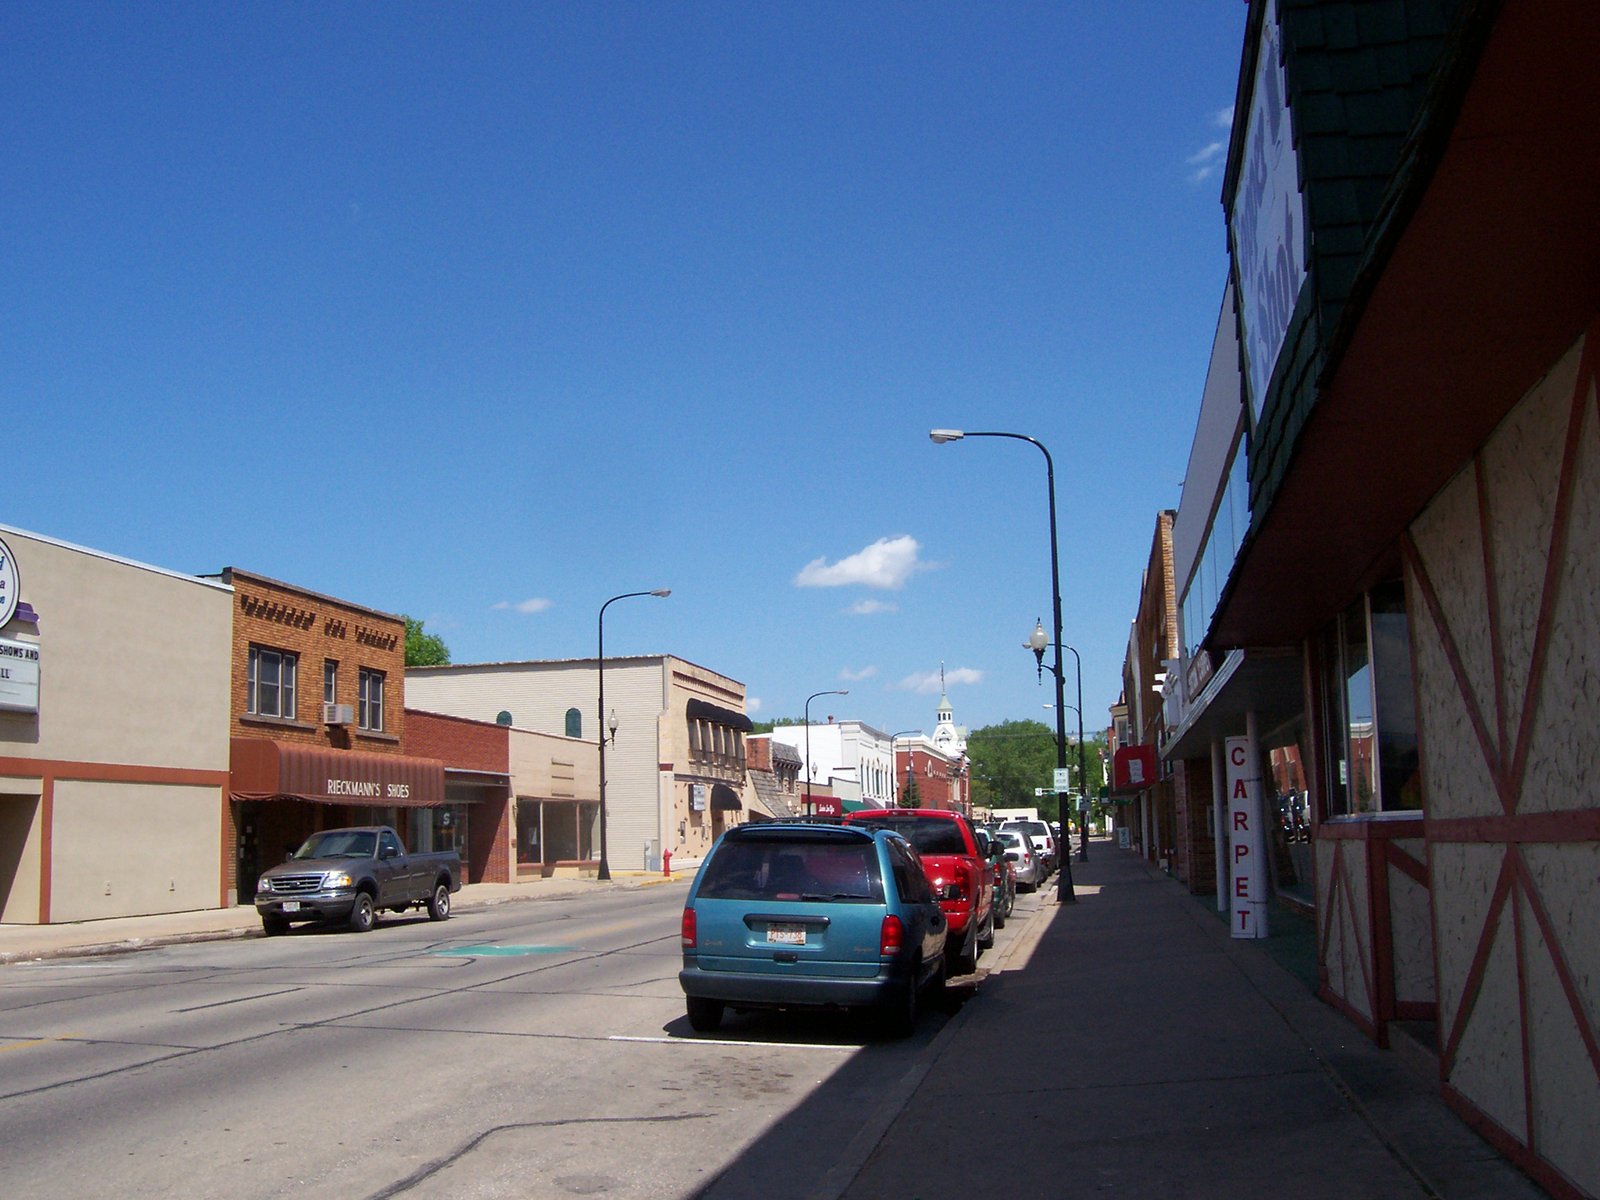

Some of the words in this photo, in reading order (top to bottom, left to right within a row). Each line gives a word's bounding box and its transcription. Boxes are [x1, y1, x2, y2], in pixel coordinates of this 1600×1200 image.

[0, 644, 23, 658] SHOWS
[25, 649, 39, 661] AND
[0, 668, 10, 680] LL
[327, 779, 381, 797] RIECKMANN'S
[387, 783, 410, 798] SHOES
[1231, 746, 1250, 930] CARPET
